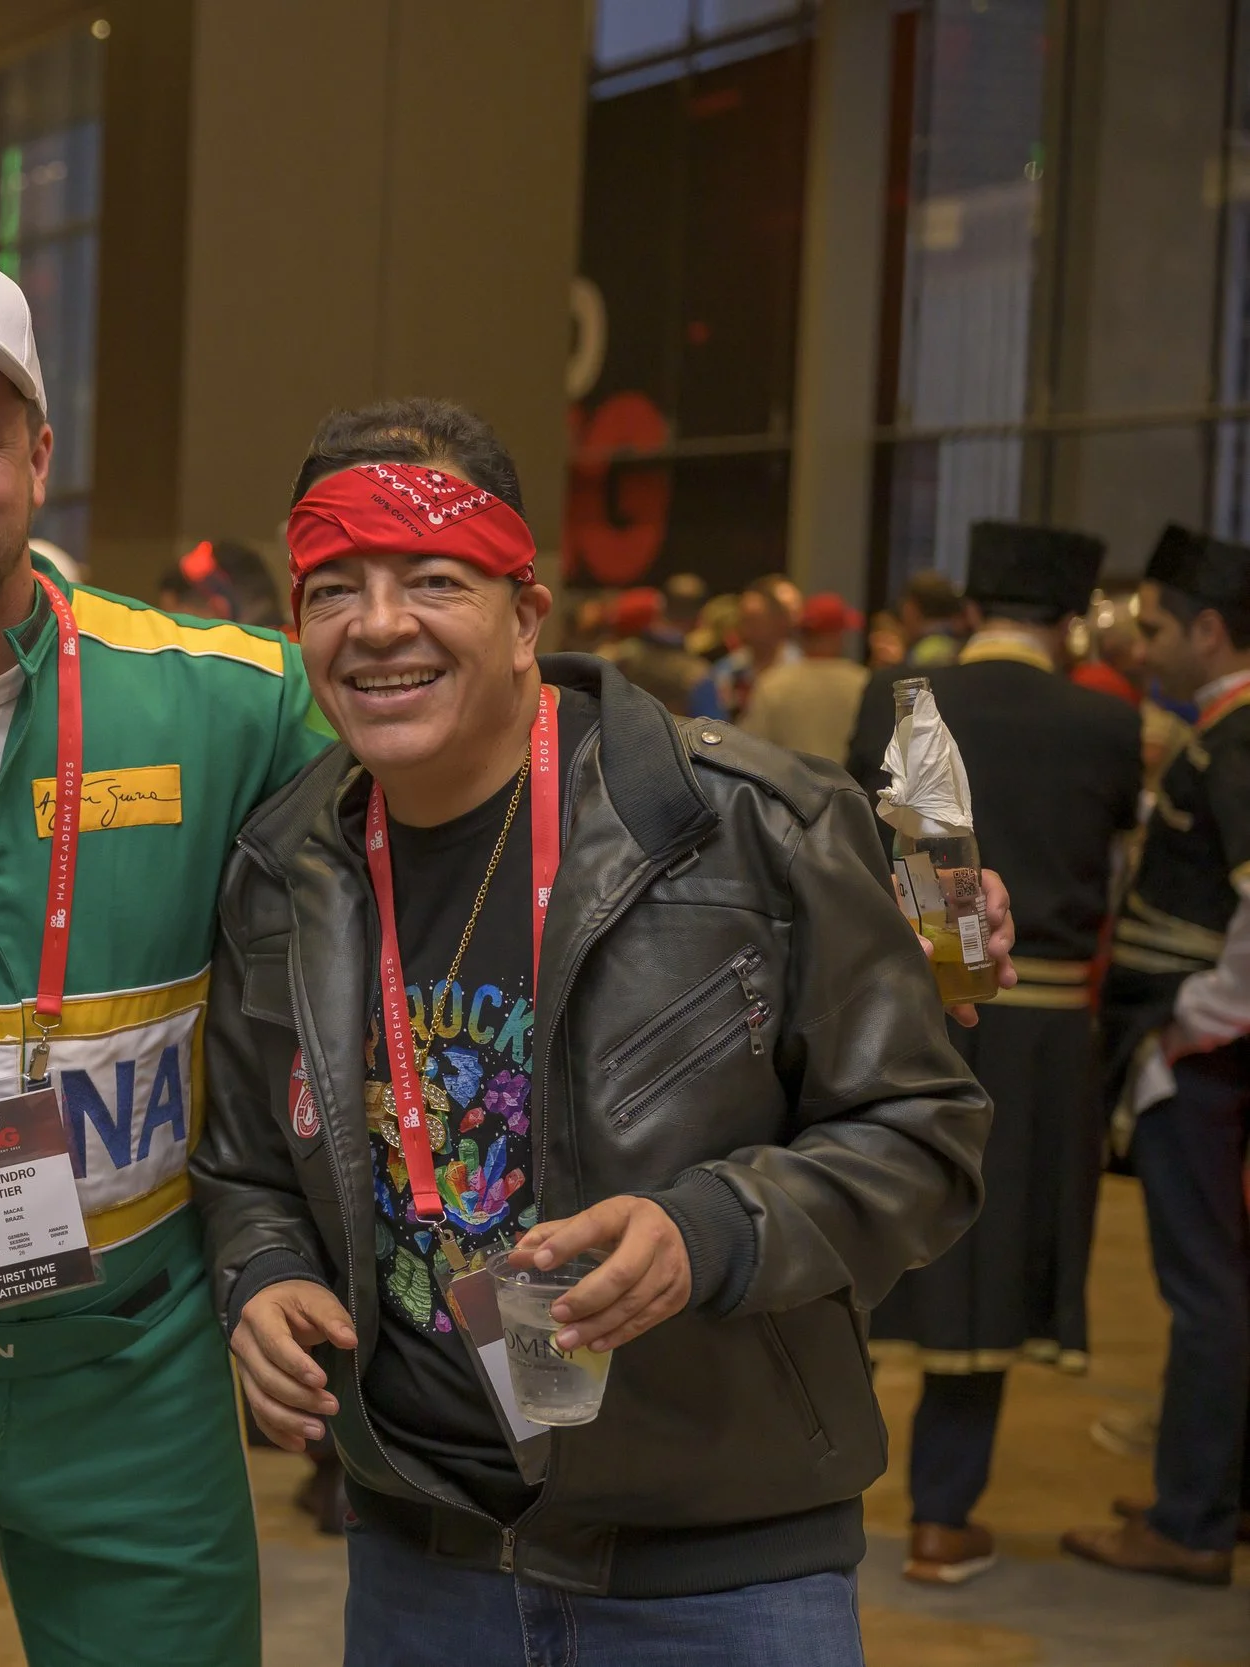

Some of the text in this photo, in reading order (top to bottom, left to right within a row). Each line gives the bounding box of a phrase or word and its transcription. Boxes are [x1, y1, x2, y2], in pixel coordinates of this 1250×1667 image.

[391, 508, 424, 538] COTTON
[68, 636, 76, 656] BIG
[539, 740, 549, 772] 2025
[56, 761, 75, 901] HALACADEMY 2025
[374, 829, 384, 849] BIG
[55, 908, 66, 929] BIG
[386, 957, 413, 1100] HALACADEMY 2025
[409, 1106, 421, 1128] BIG
[4, 1214, 25, 1224] BRAZIL
[48, 1224, 69, 1234] AWARDS
[7, 1231, 30, 1241] GENERAL
[9, 1237, 31, 1246] SESSION
[50, 1230, 69, 1239] DINNER
[8, 1242, 34, 1252] THURSDAY
[28, 1262, 57, 1278] TIME
